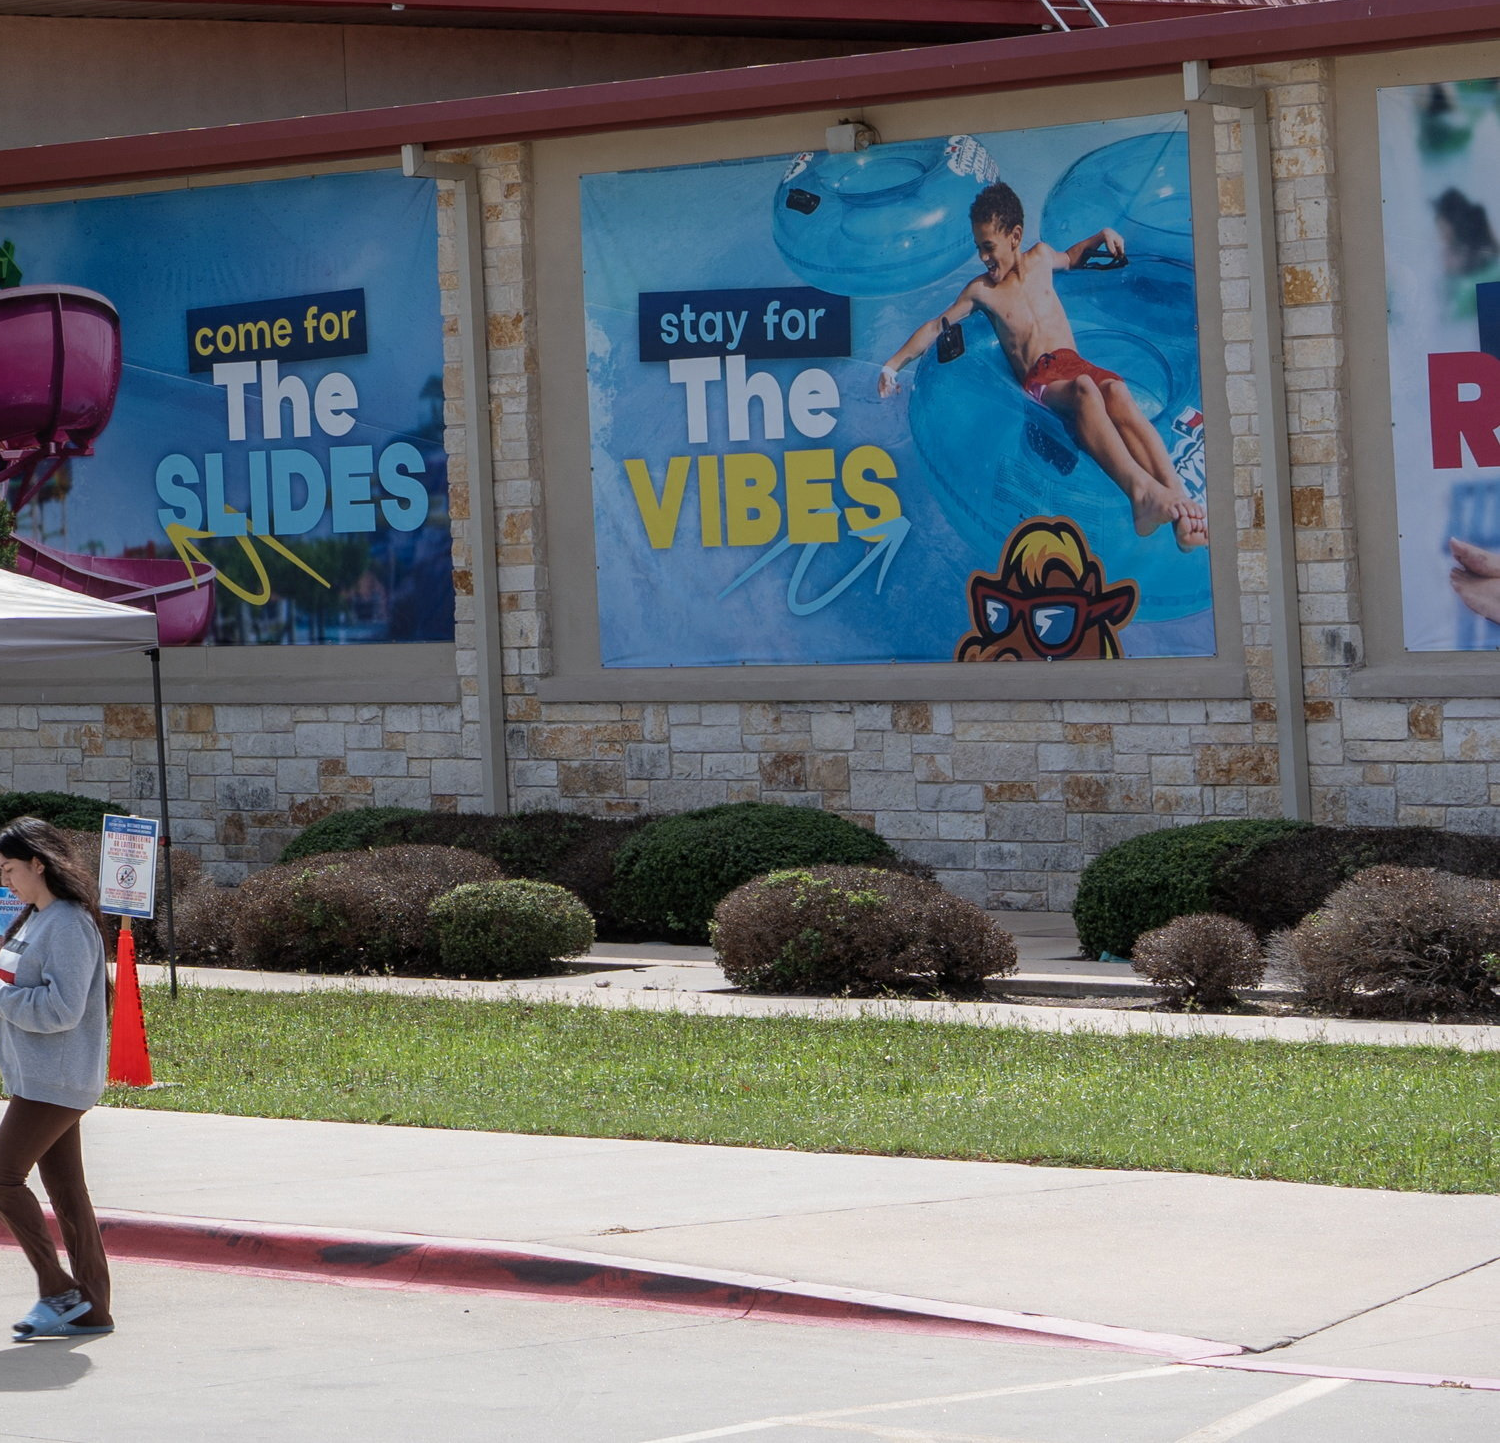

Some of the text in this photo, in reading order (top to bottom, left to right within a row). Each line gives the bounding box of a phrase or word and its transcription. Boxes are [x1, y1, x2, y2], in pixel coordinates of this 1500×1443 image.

[194, 305, 357, 357] come for
[660, 300, 827, 351] stay for
[213, 359, 359, 441] The
[669, 354, 842, 444] The
[155, 441, 430, 538] SLIDES
[623, 445, 902, 550] VIBES
